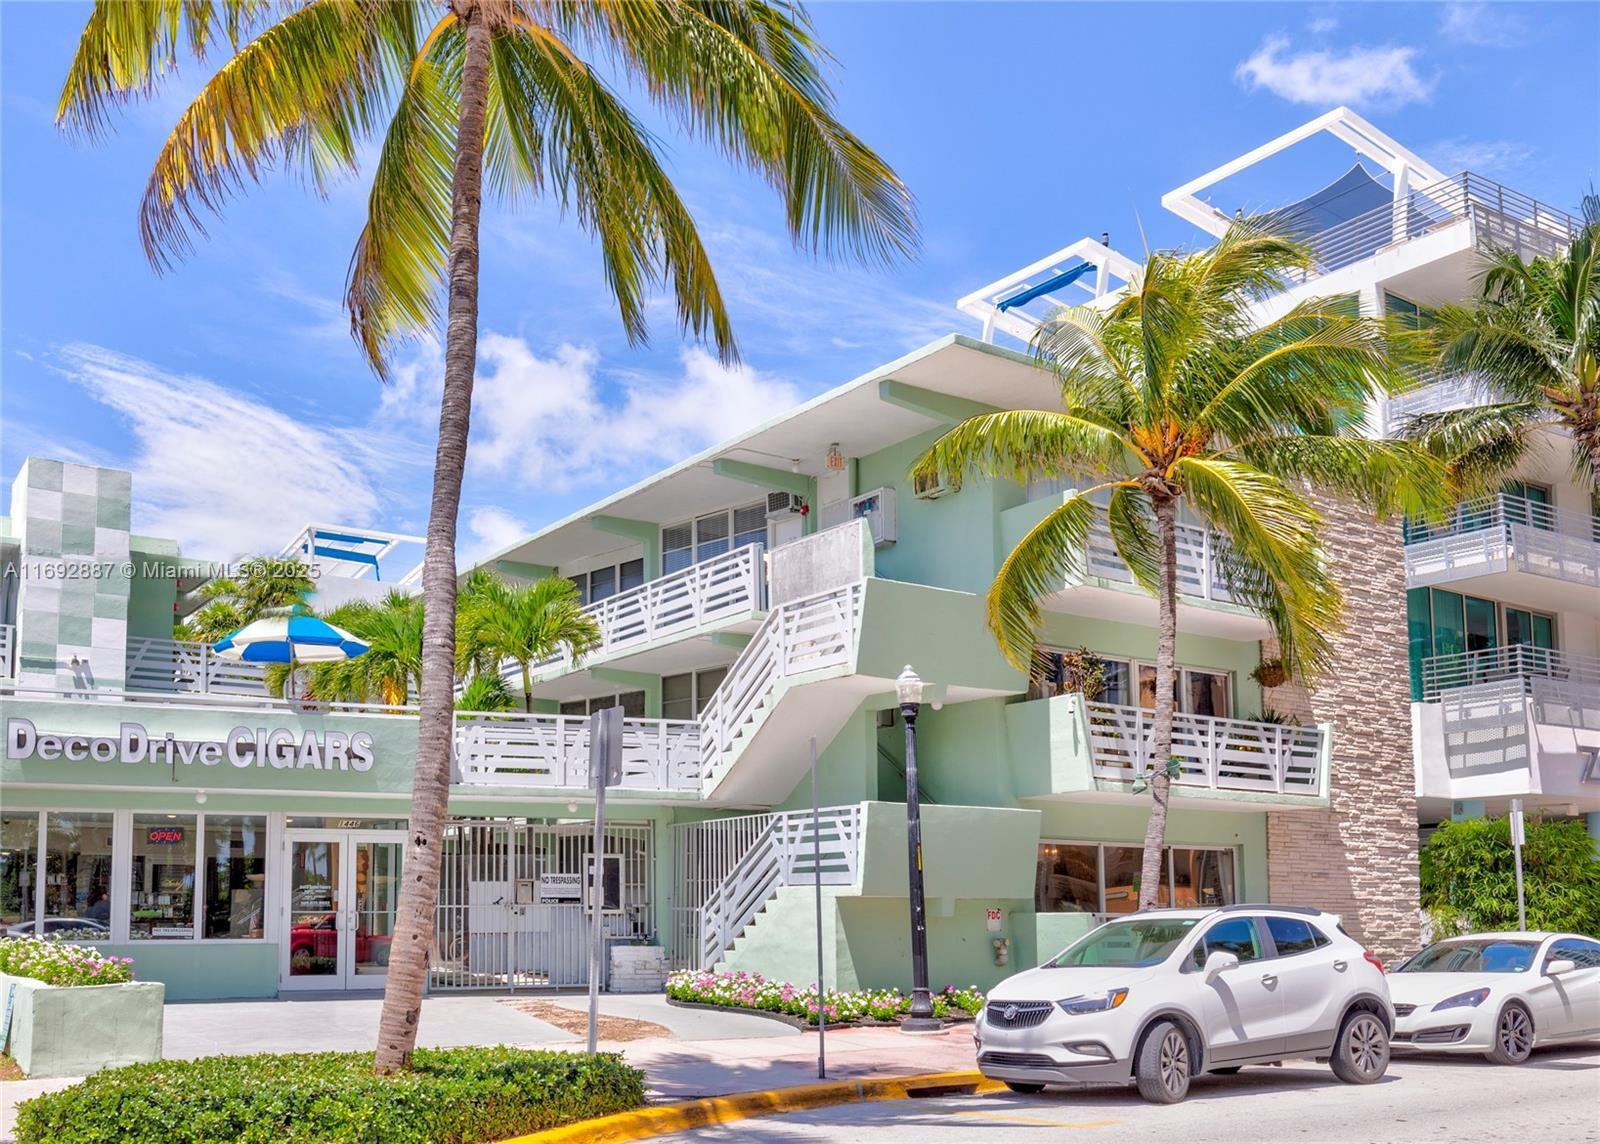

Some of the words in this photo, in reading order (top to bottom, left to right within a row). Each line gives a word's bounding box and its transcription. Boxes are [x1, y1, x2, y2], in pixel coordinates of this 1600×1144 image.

[149, 831, 182, 840] OPEN
[541, 876, 549, 884] NO
[550, 876, 581, 884] TRESPASSING
[987, 911, 1000, 920] FDC
